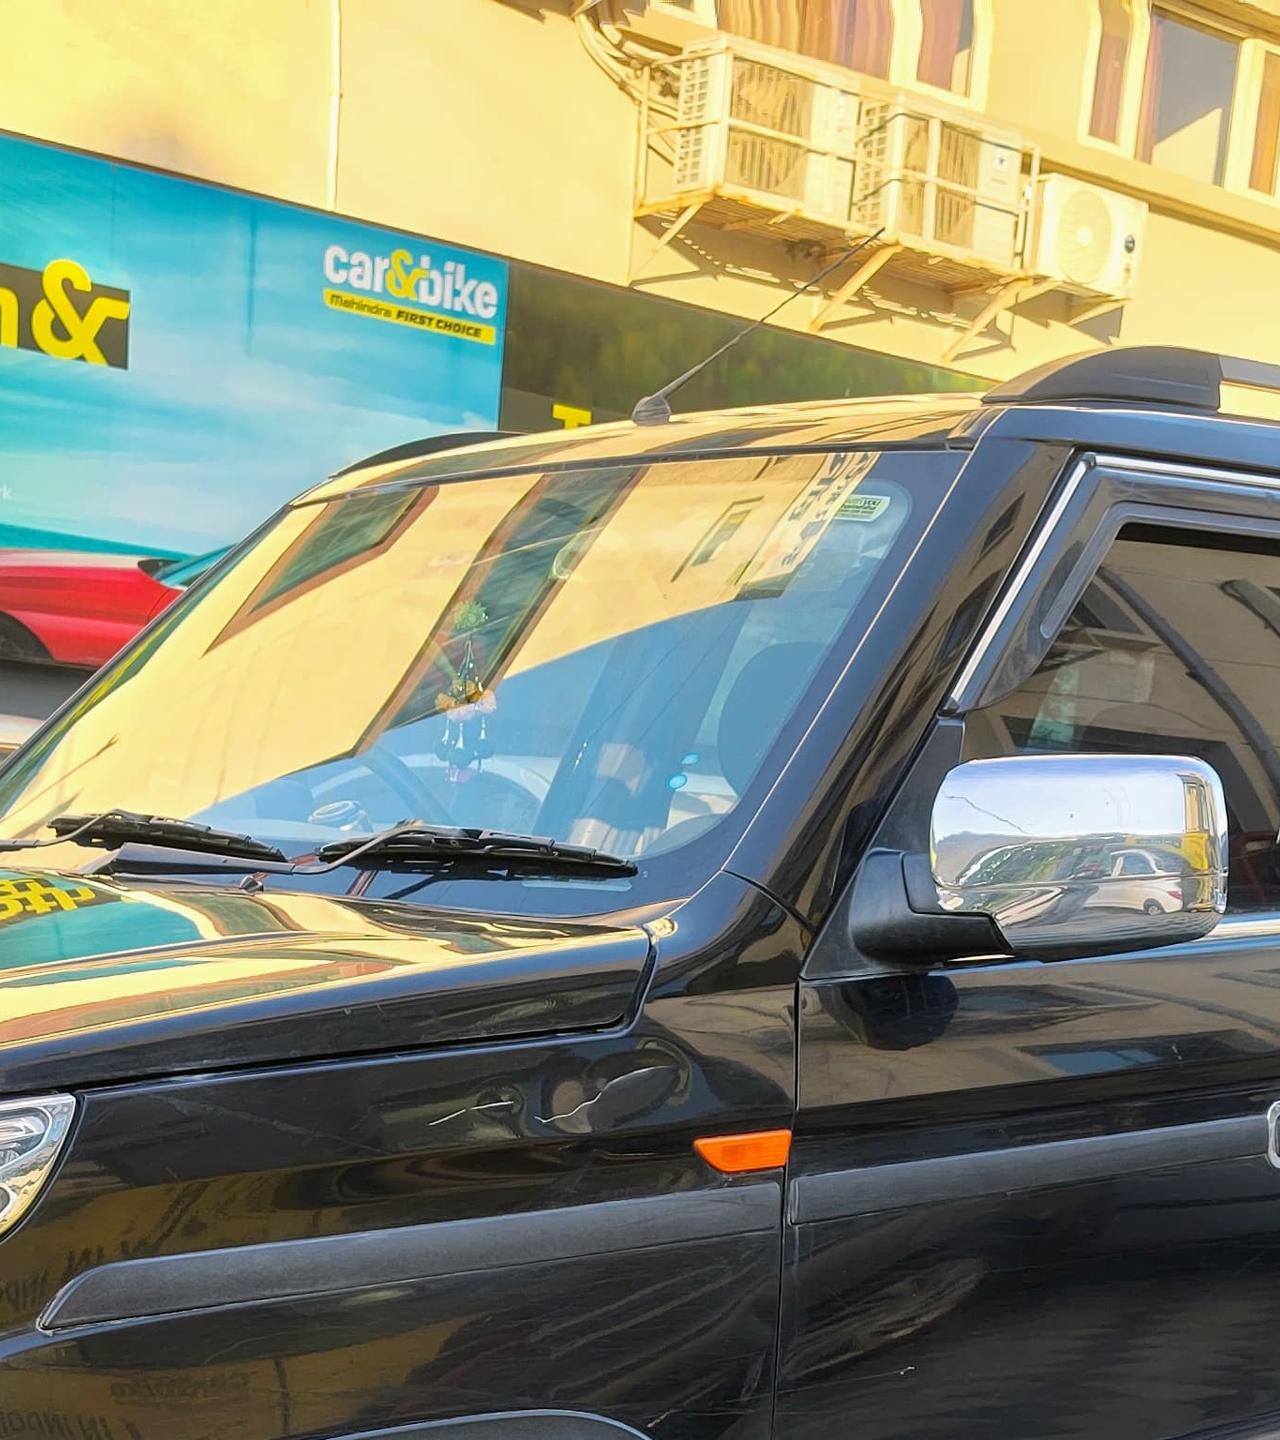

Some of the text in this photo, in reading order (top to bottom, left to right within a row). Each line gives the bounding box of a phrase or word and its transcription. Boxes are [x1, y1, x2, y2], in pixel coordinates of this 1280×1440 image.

[30, 258, 130, 366] &
[324, 245, 498, 319] car&bike
[396, 308, 434, 327] FIRST
[436, 319, 482, 338] CHOICE
